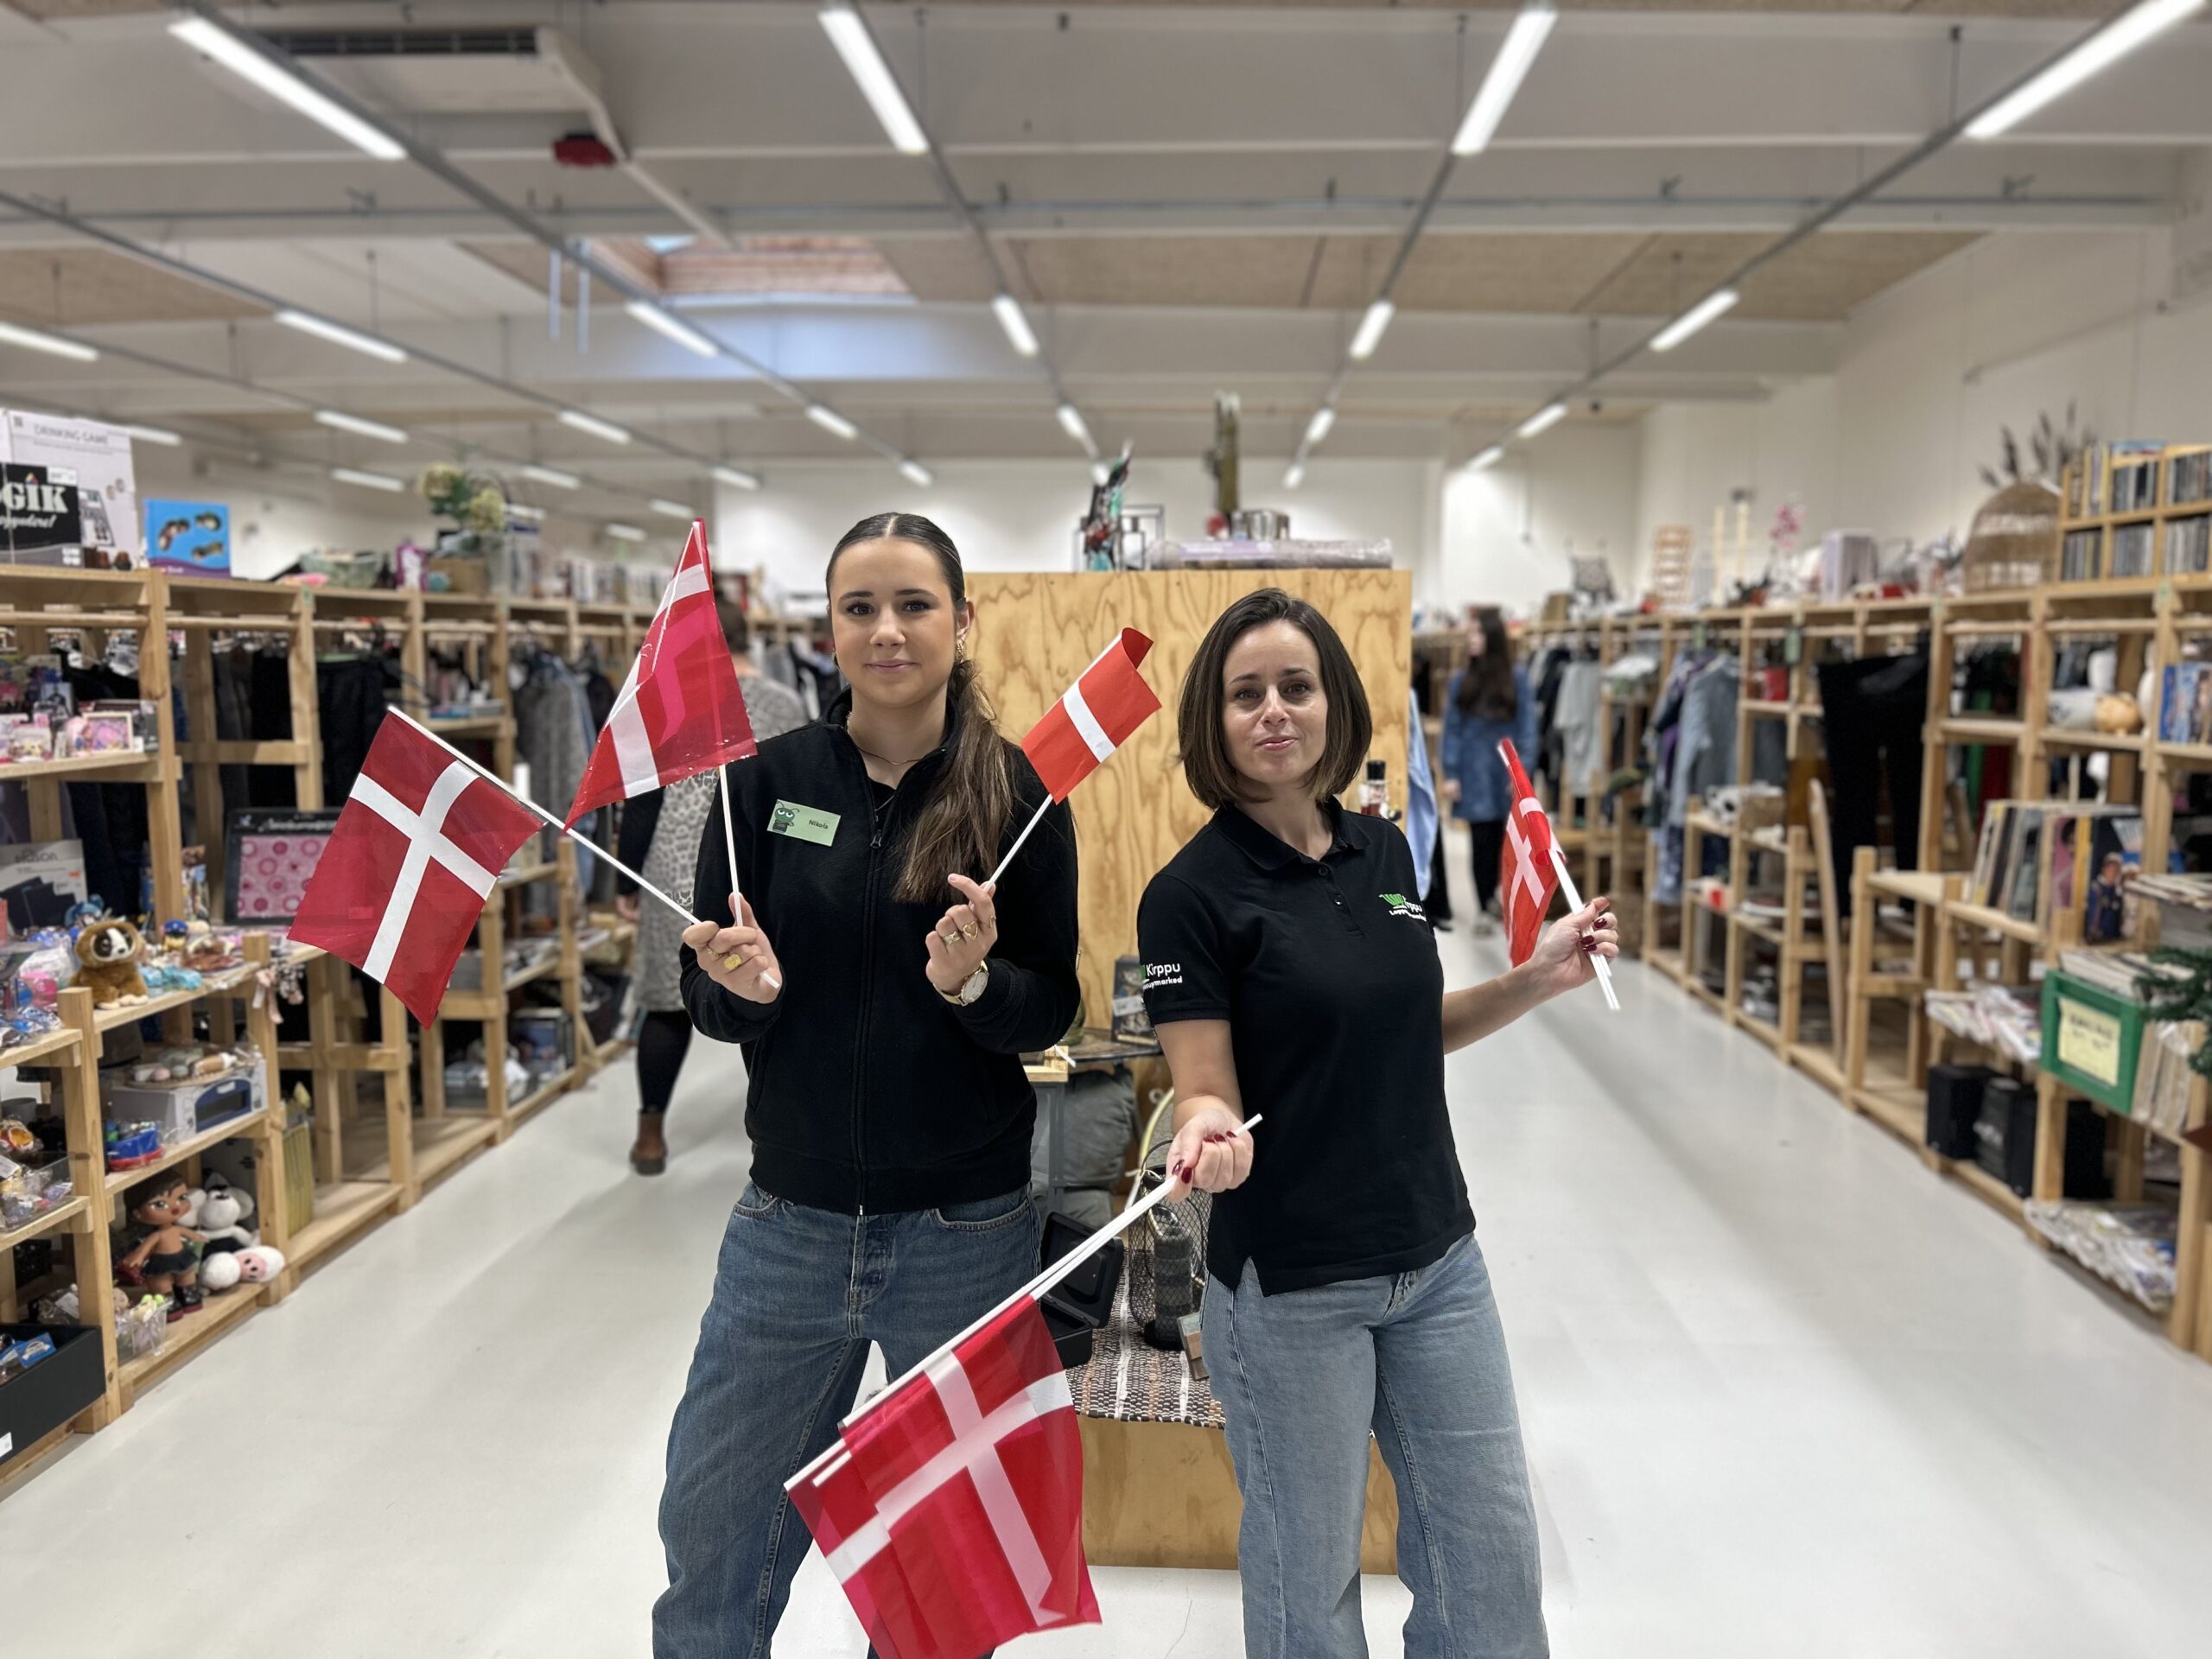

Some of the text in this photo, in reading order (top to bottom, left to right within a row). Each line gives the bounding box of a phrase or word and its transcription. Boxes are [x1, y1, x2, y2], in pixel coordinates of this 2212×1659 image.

[0, 482, 68, 513] GIK
[809, 819, 828, 829] Nikola
[1146, 963, 1180, 976] Kirppu
